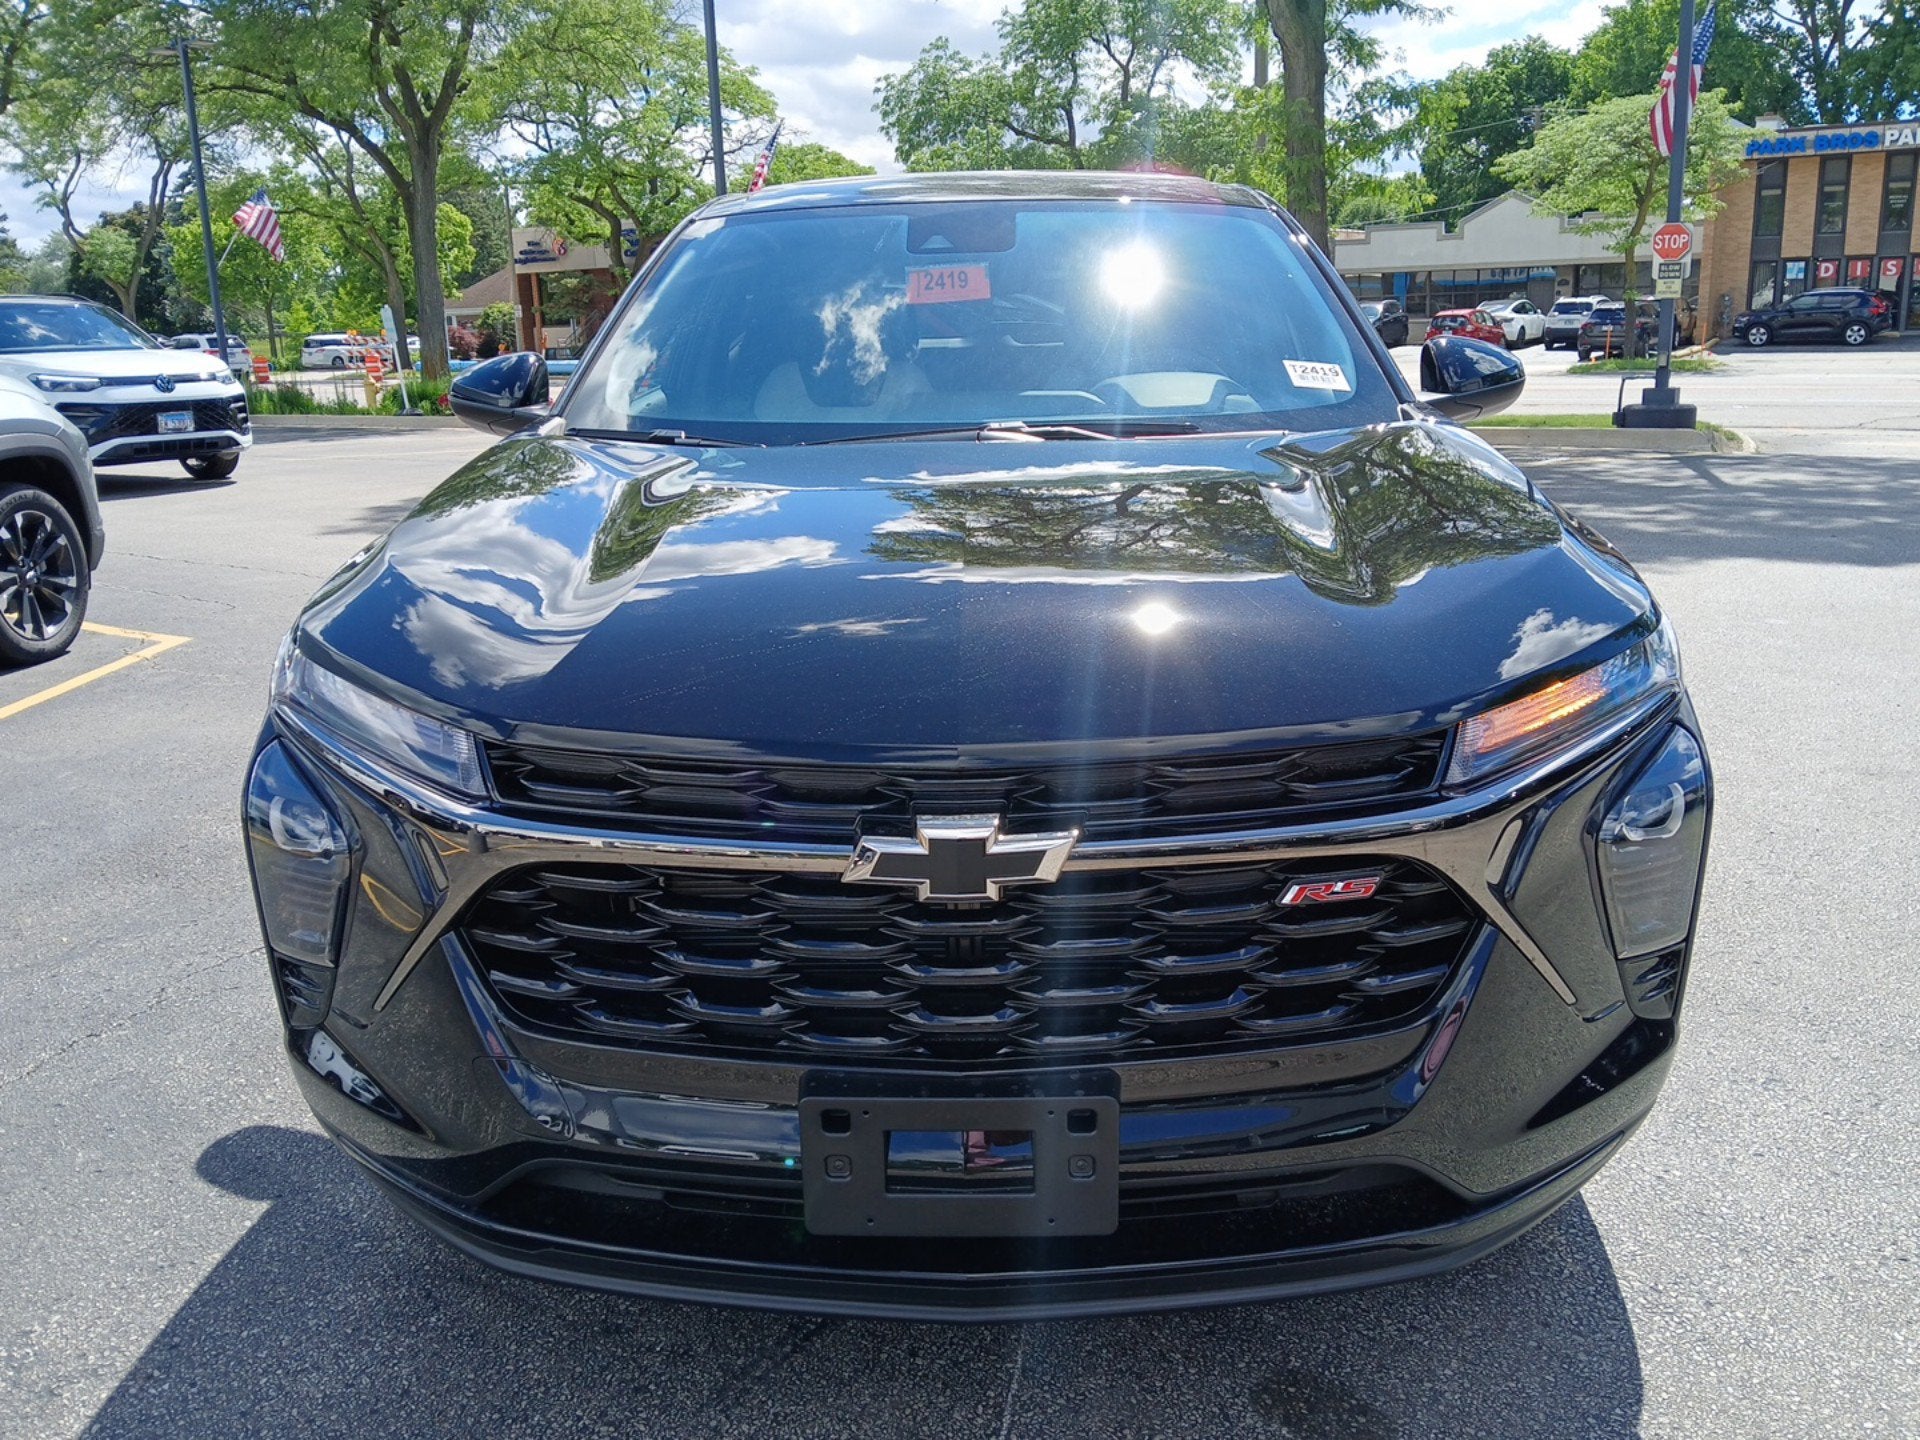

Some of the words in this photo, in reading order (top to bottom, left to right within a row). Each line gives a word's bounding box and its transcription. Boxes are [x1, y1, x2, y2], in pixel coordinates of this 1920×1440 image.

[1746, 135, 1808, 156] PARK
[1814, 131, 1880, 151] BROS
[1884, 127, 1920, 147] PA
[1654, 234, 1690, 249] STOP
[1289, 363, 1340, 377] T2419
[1281, 877, 1380, 904] RS
